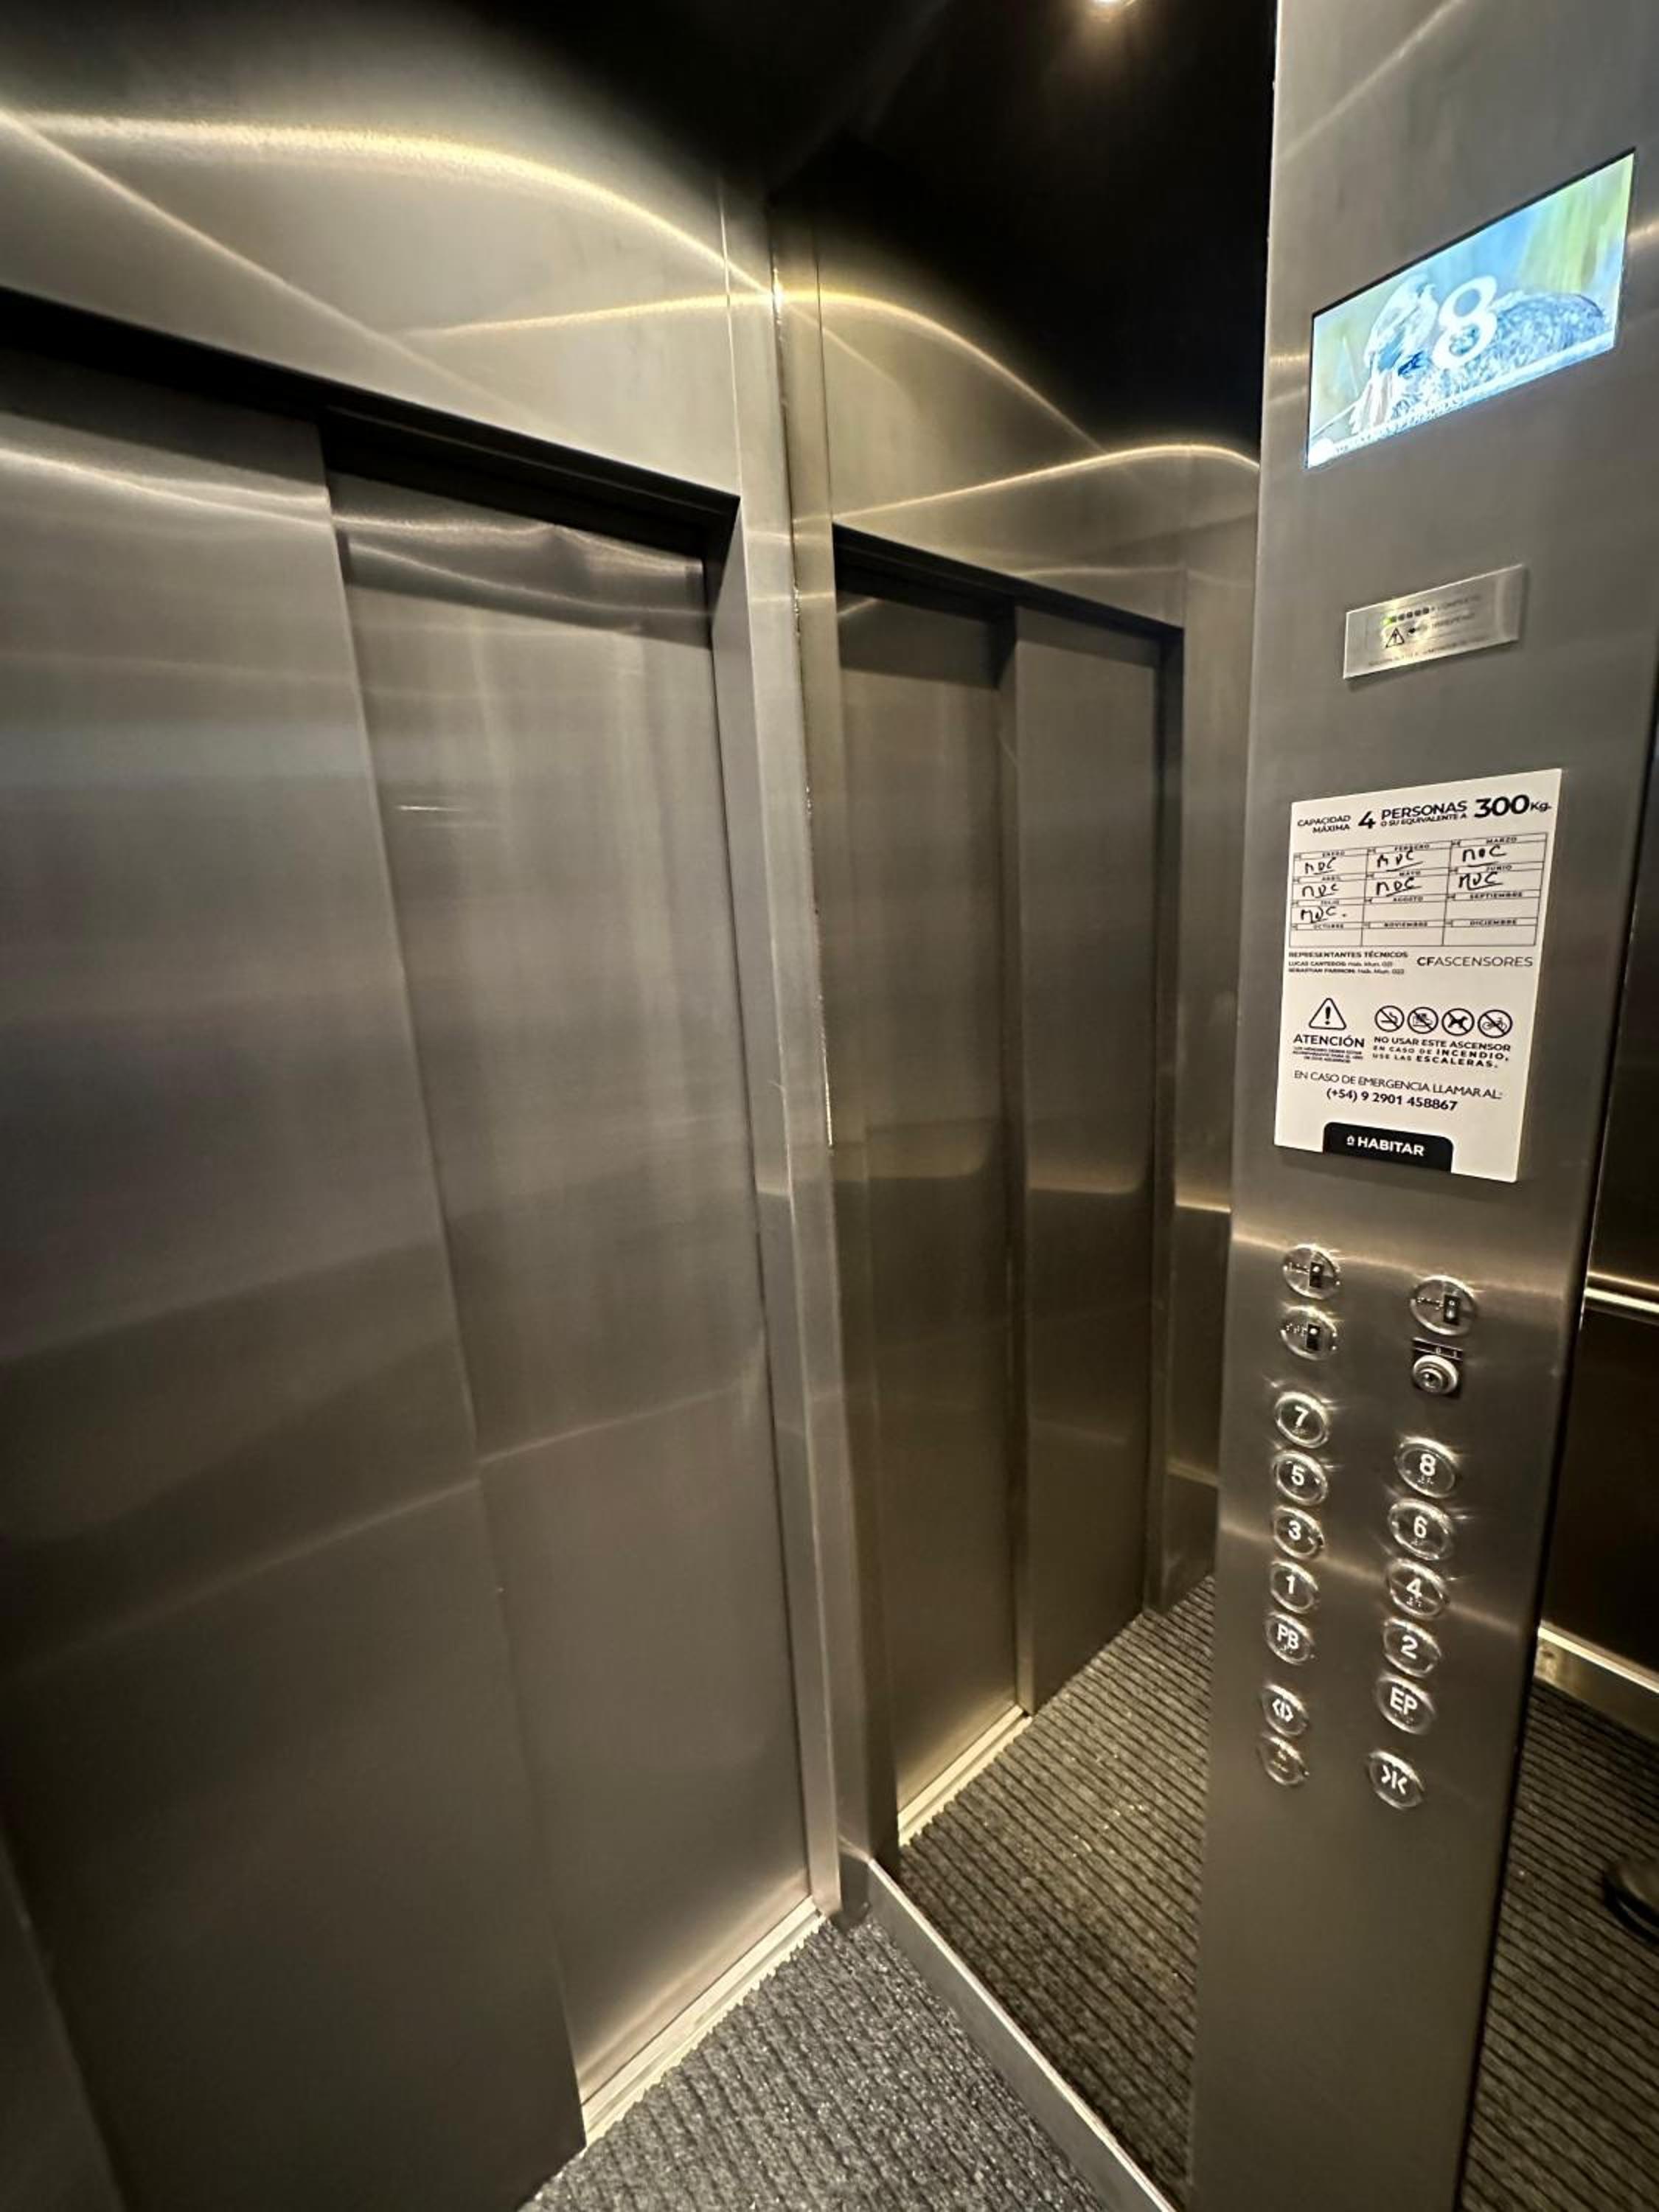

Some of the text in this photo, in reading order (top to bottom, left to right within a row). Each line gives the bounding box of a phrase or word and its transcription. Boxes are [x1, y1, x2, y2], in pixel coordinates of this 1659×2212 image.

[1432, 274, 1498, 369] 8
[1297, 815, 1351, 827] CAPACIDAD
[1358, 811, 1376, 830] 4
[1381, 801, 1467, 820] PERSONAS
[1416, 956, 1533, 967] CFASCENSORES
[1293, 1034, 1365, 1048] ATENCIÓN
[1391, 1037, 1419, 1046] USAR
[1422, 1039, 1447, 1047] ESTE
[1450, 1040, 1511, 1051] ASCENSOR
[1294, 1071, 1308, 1079] EN
[1310, 1071, 1340, 1082] CASO
[1342, 1075, 1357, 1085] DE
[1358, 1077, 1430, 1092] EMERGENCIA
[1433, 1083, 1482, 1097] LLAMAR
[1327, 1088, 1458, 1111] (+54) 9 2901 458867
[1357, 1136, 1425, 1156] HABITAR
[1294, 1405, 1309, 1427] 7
[1291, 1464, 1305, 1486] 5
[1419, 1453, 1436, 1477] 8
[1288, 1520, 1301, 1540] 3
[1413, 1515, 1428, 1539] 6
[1286, 1574, 1295, 1594] 1
[1406, 1578, 1422, 1599] 4
[1277, 1623, 1299, 1650] PB
[1400, 1635, 1419, 1660] 2
[1390, 1686, 1419, 1716] EP
